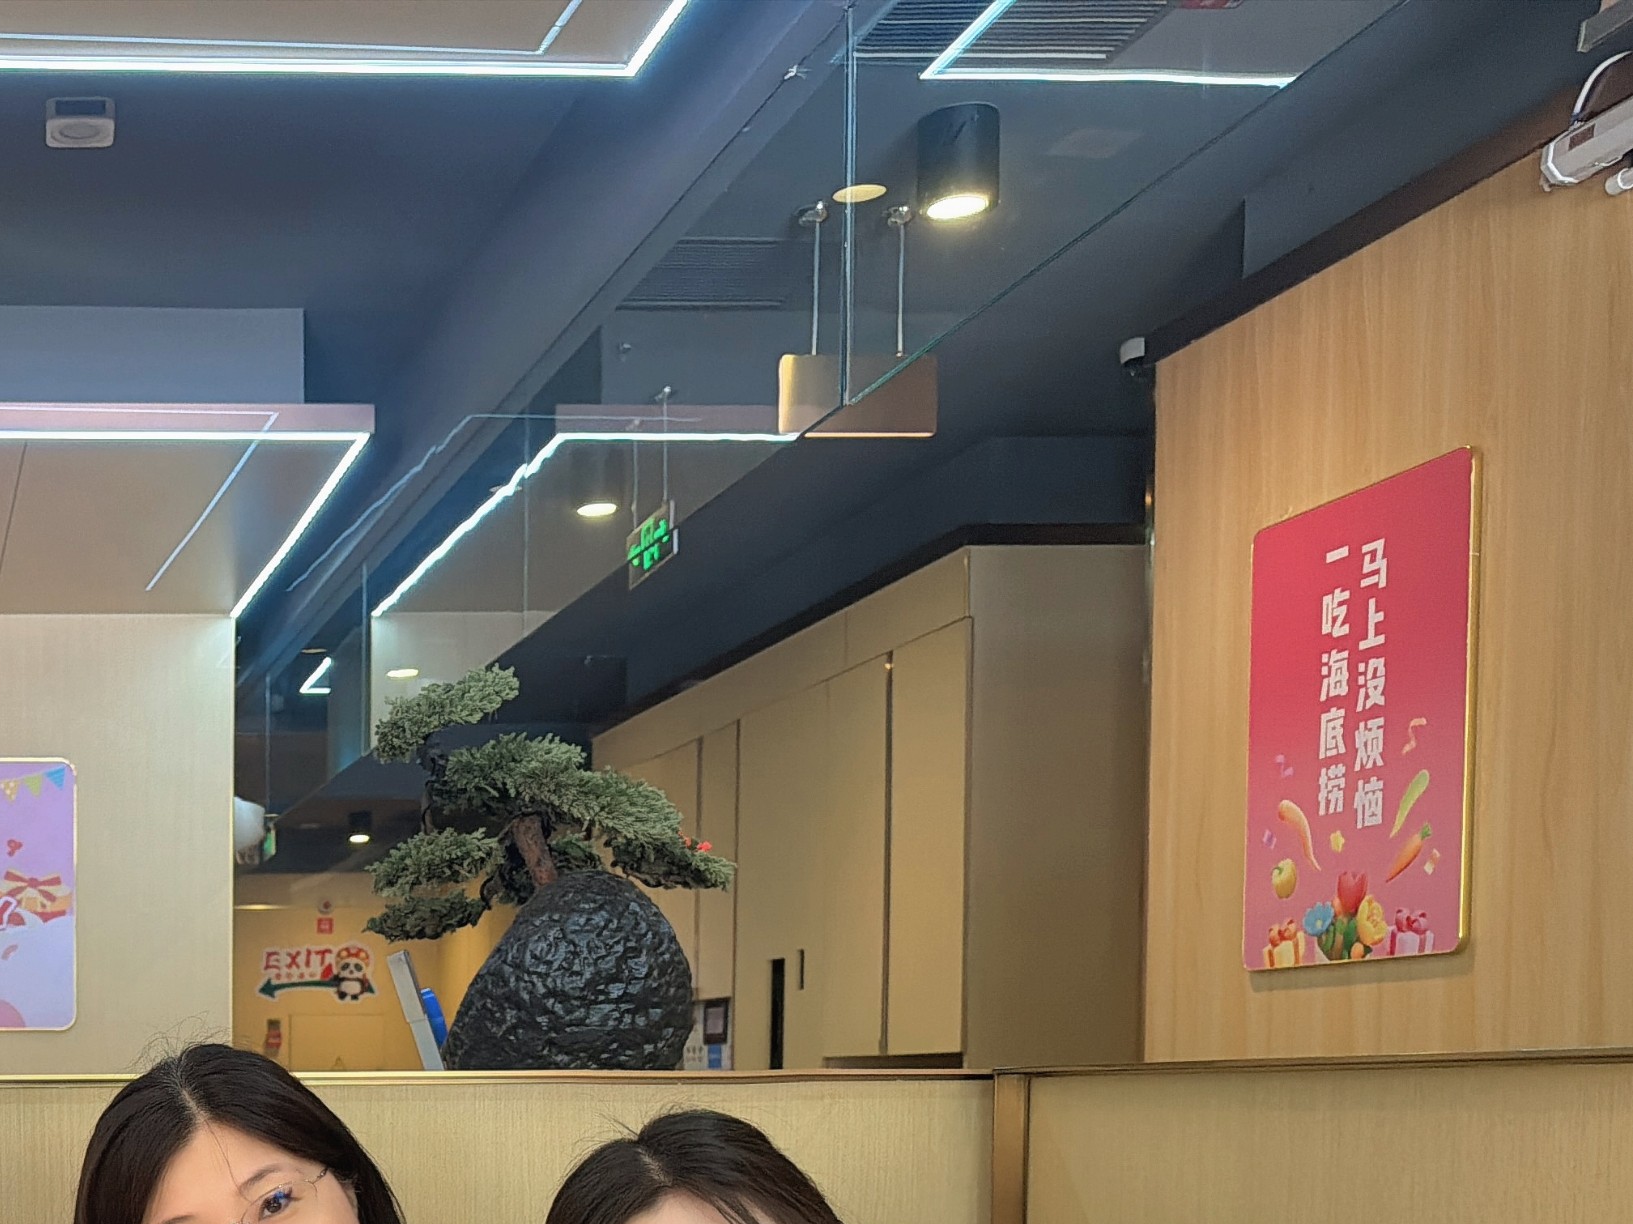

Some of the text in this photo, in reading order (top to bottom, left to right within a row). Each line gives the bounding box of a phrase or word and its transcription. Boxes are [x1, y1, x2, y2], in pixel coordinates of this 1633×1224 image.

[1317, 544, 1351, 817] 一吃海底捞
[1353, 537, 1388, 830] 马上没烦恼
[263, 948, 333, 971] EXIT
